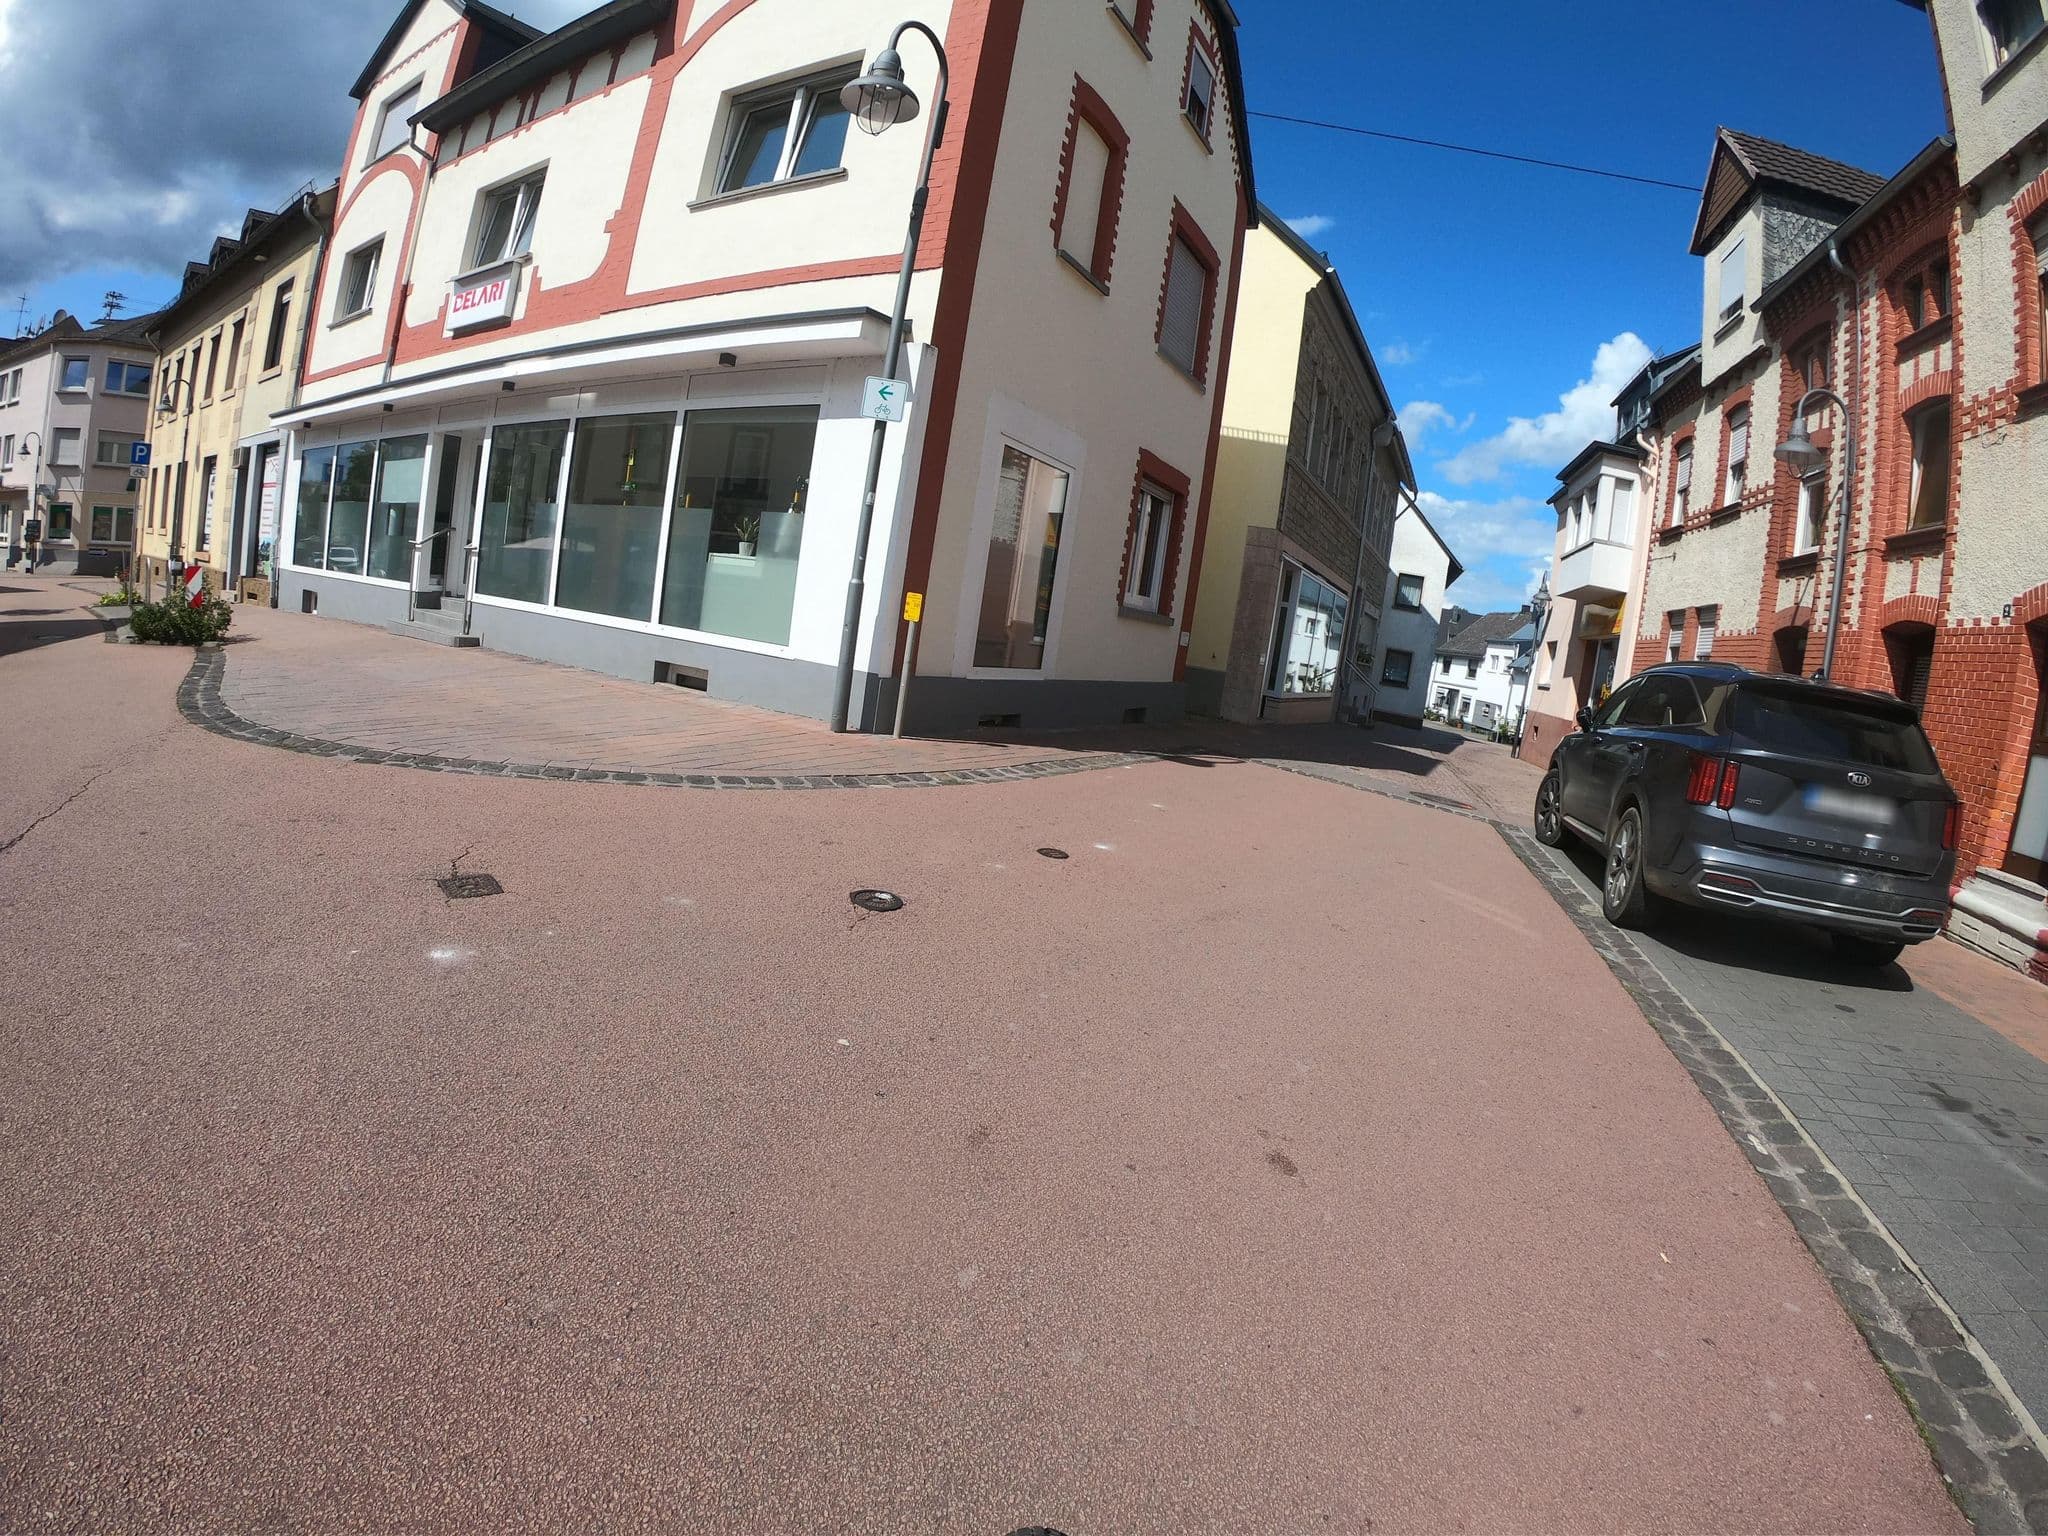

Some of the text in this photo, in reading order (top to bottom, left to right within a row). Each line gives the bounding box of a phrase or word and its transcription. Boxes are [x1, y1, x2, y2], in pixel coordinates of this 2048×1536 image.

[453, 280, 505, 313] DELARI
[135, 445, 148, 462] P
[1851, 774, 1869, 786] KIA
[1788, 836, 1900, 862] SORENTO
